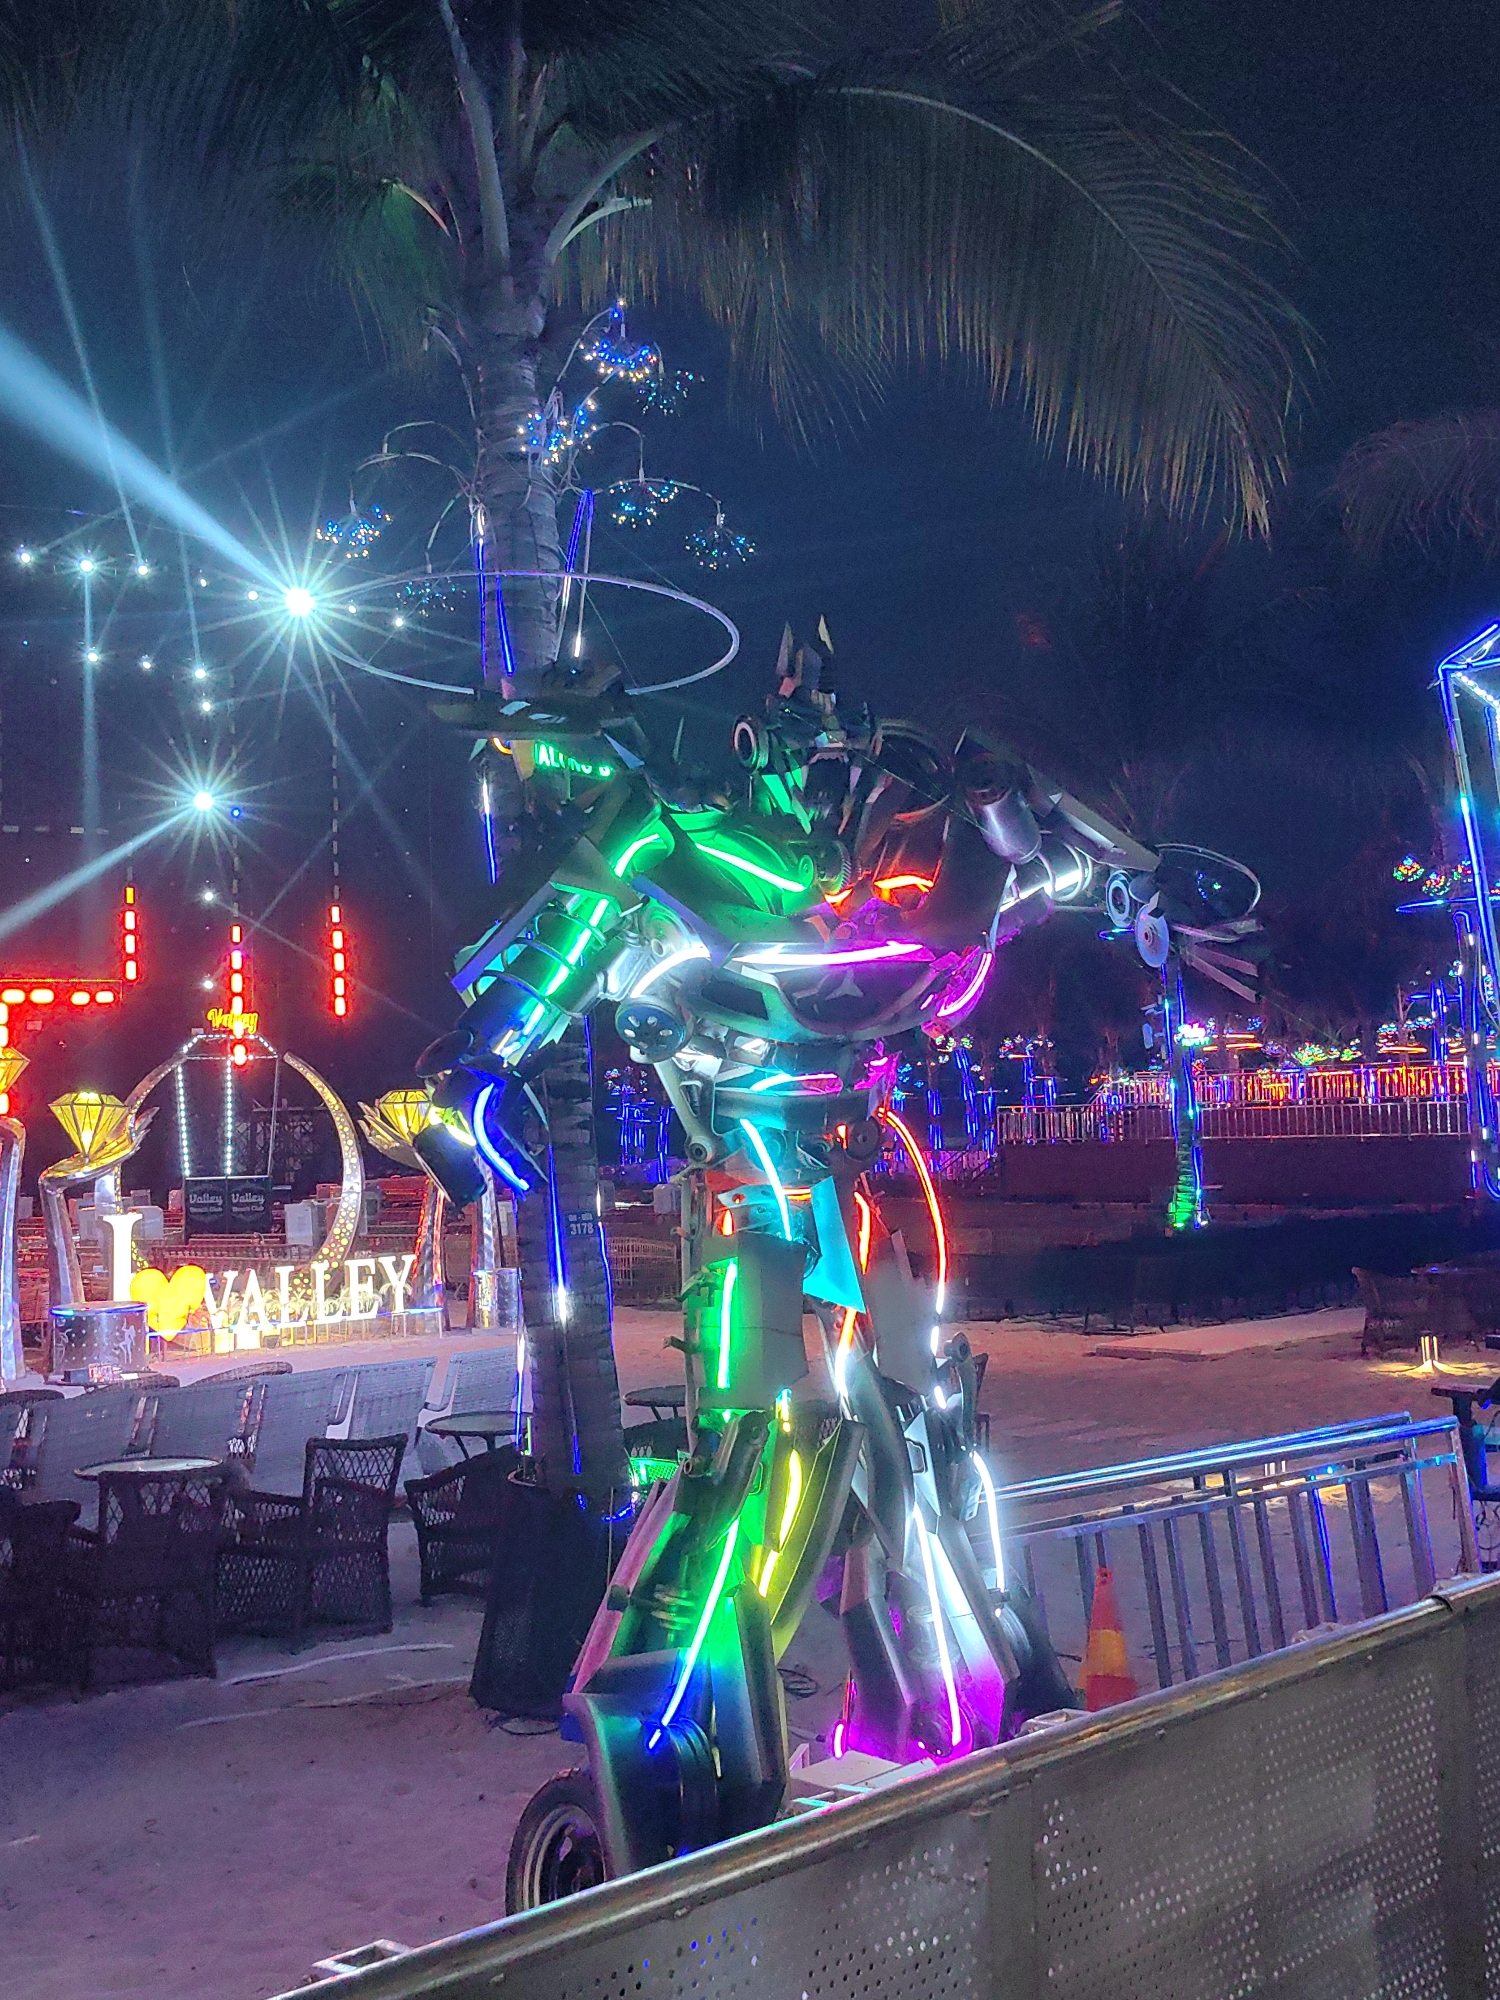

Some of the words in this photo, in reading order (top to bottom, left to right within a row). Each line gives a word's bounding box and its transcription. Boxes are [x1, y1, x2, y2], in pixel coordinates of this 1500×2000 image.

[189, 1193, 223, 1206] Valley
[231, 1192, 265, 1205] Valley
[570, 1222, 594, 1235] 3178
[204, 1254, 417, 1330] VALLEY
